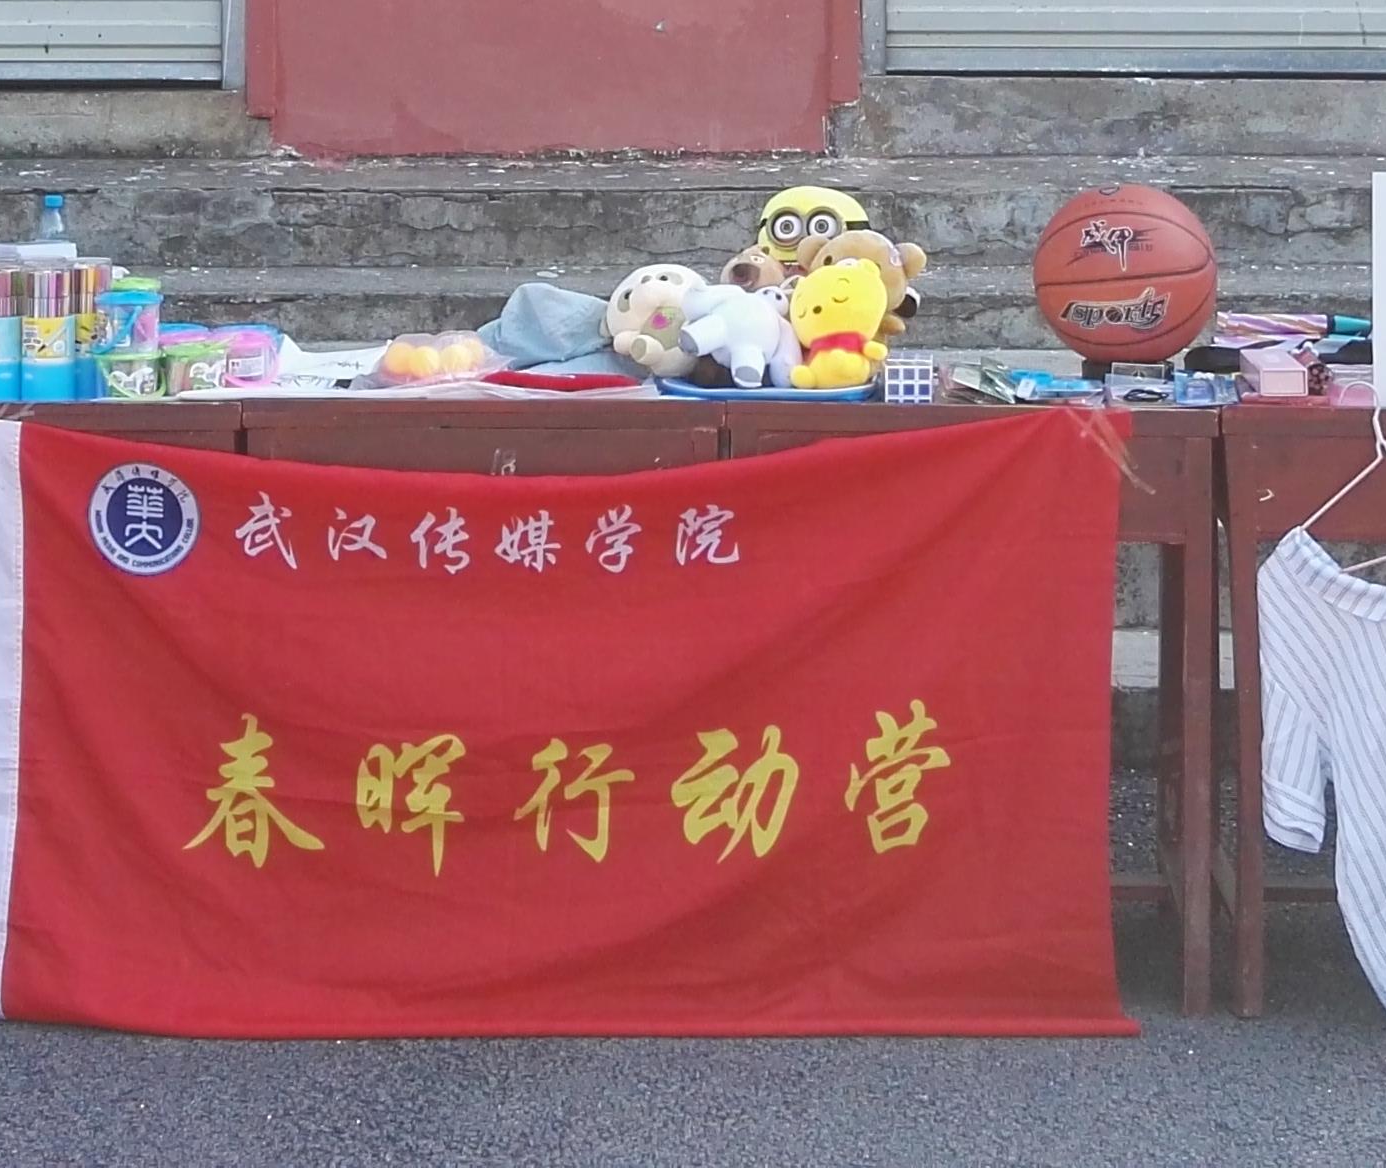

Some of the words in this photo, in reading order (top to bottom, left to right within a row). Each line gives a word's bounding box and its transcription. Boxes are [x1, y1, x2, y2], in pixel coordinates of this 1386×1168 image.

[234, 490, 741, 576] 武汉传媒学院
[182, 699, 952, 878] 春晖行动营
